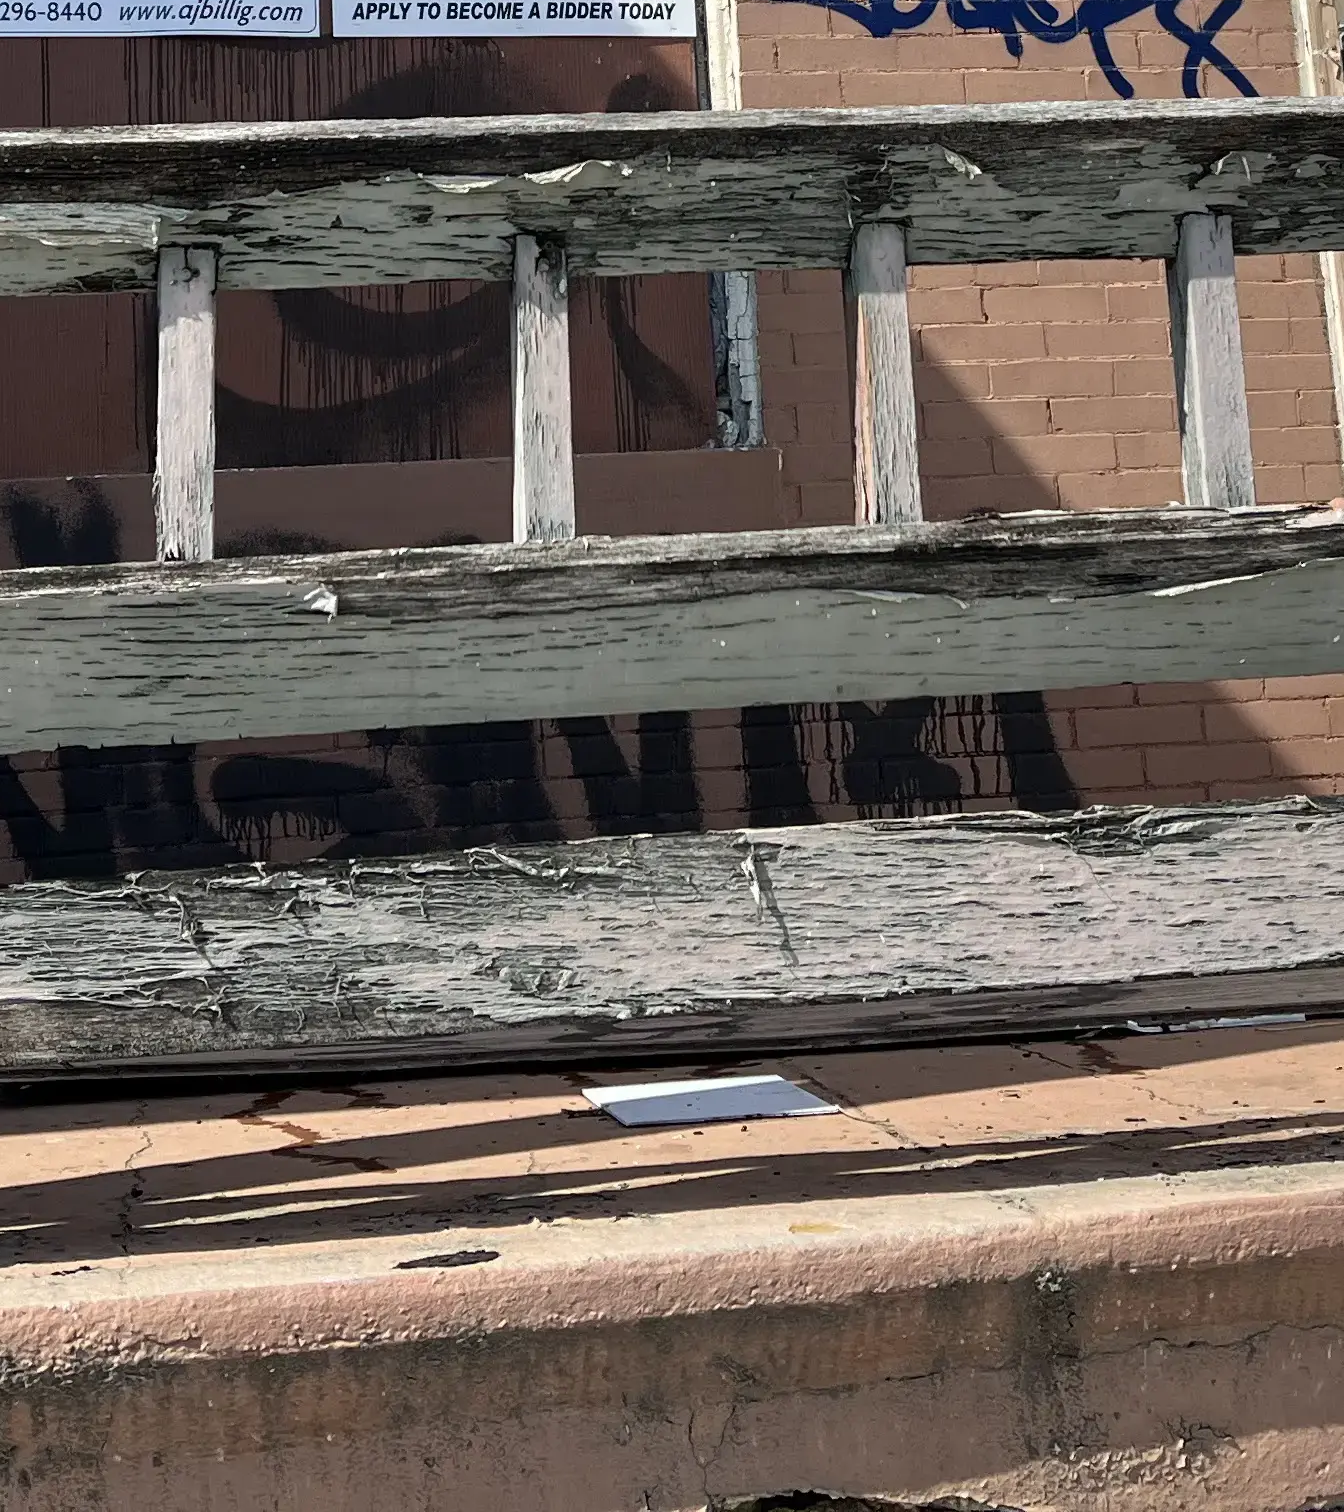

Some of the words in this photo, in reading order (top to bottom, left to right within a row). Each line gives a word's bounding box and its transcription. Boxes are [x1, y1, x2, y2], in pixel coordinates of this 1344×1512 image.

[119, 0, 303, 25] www.ajbillig.com
[352, 3, 411, 20] APPLY
[416, 4, 441, 19] TO
[446, 4, 524, 20] BECOME
[529, 3, 543, 20] A
[547, 4, 611, 20] BIDDER
[618, 3, 676, 21] TODAY
